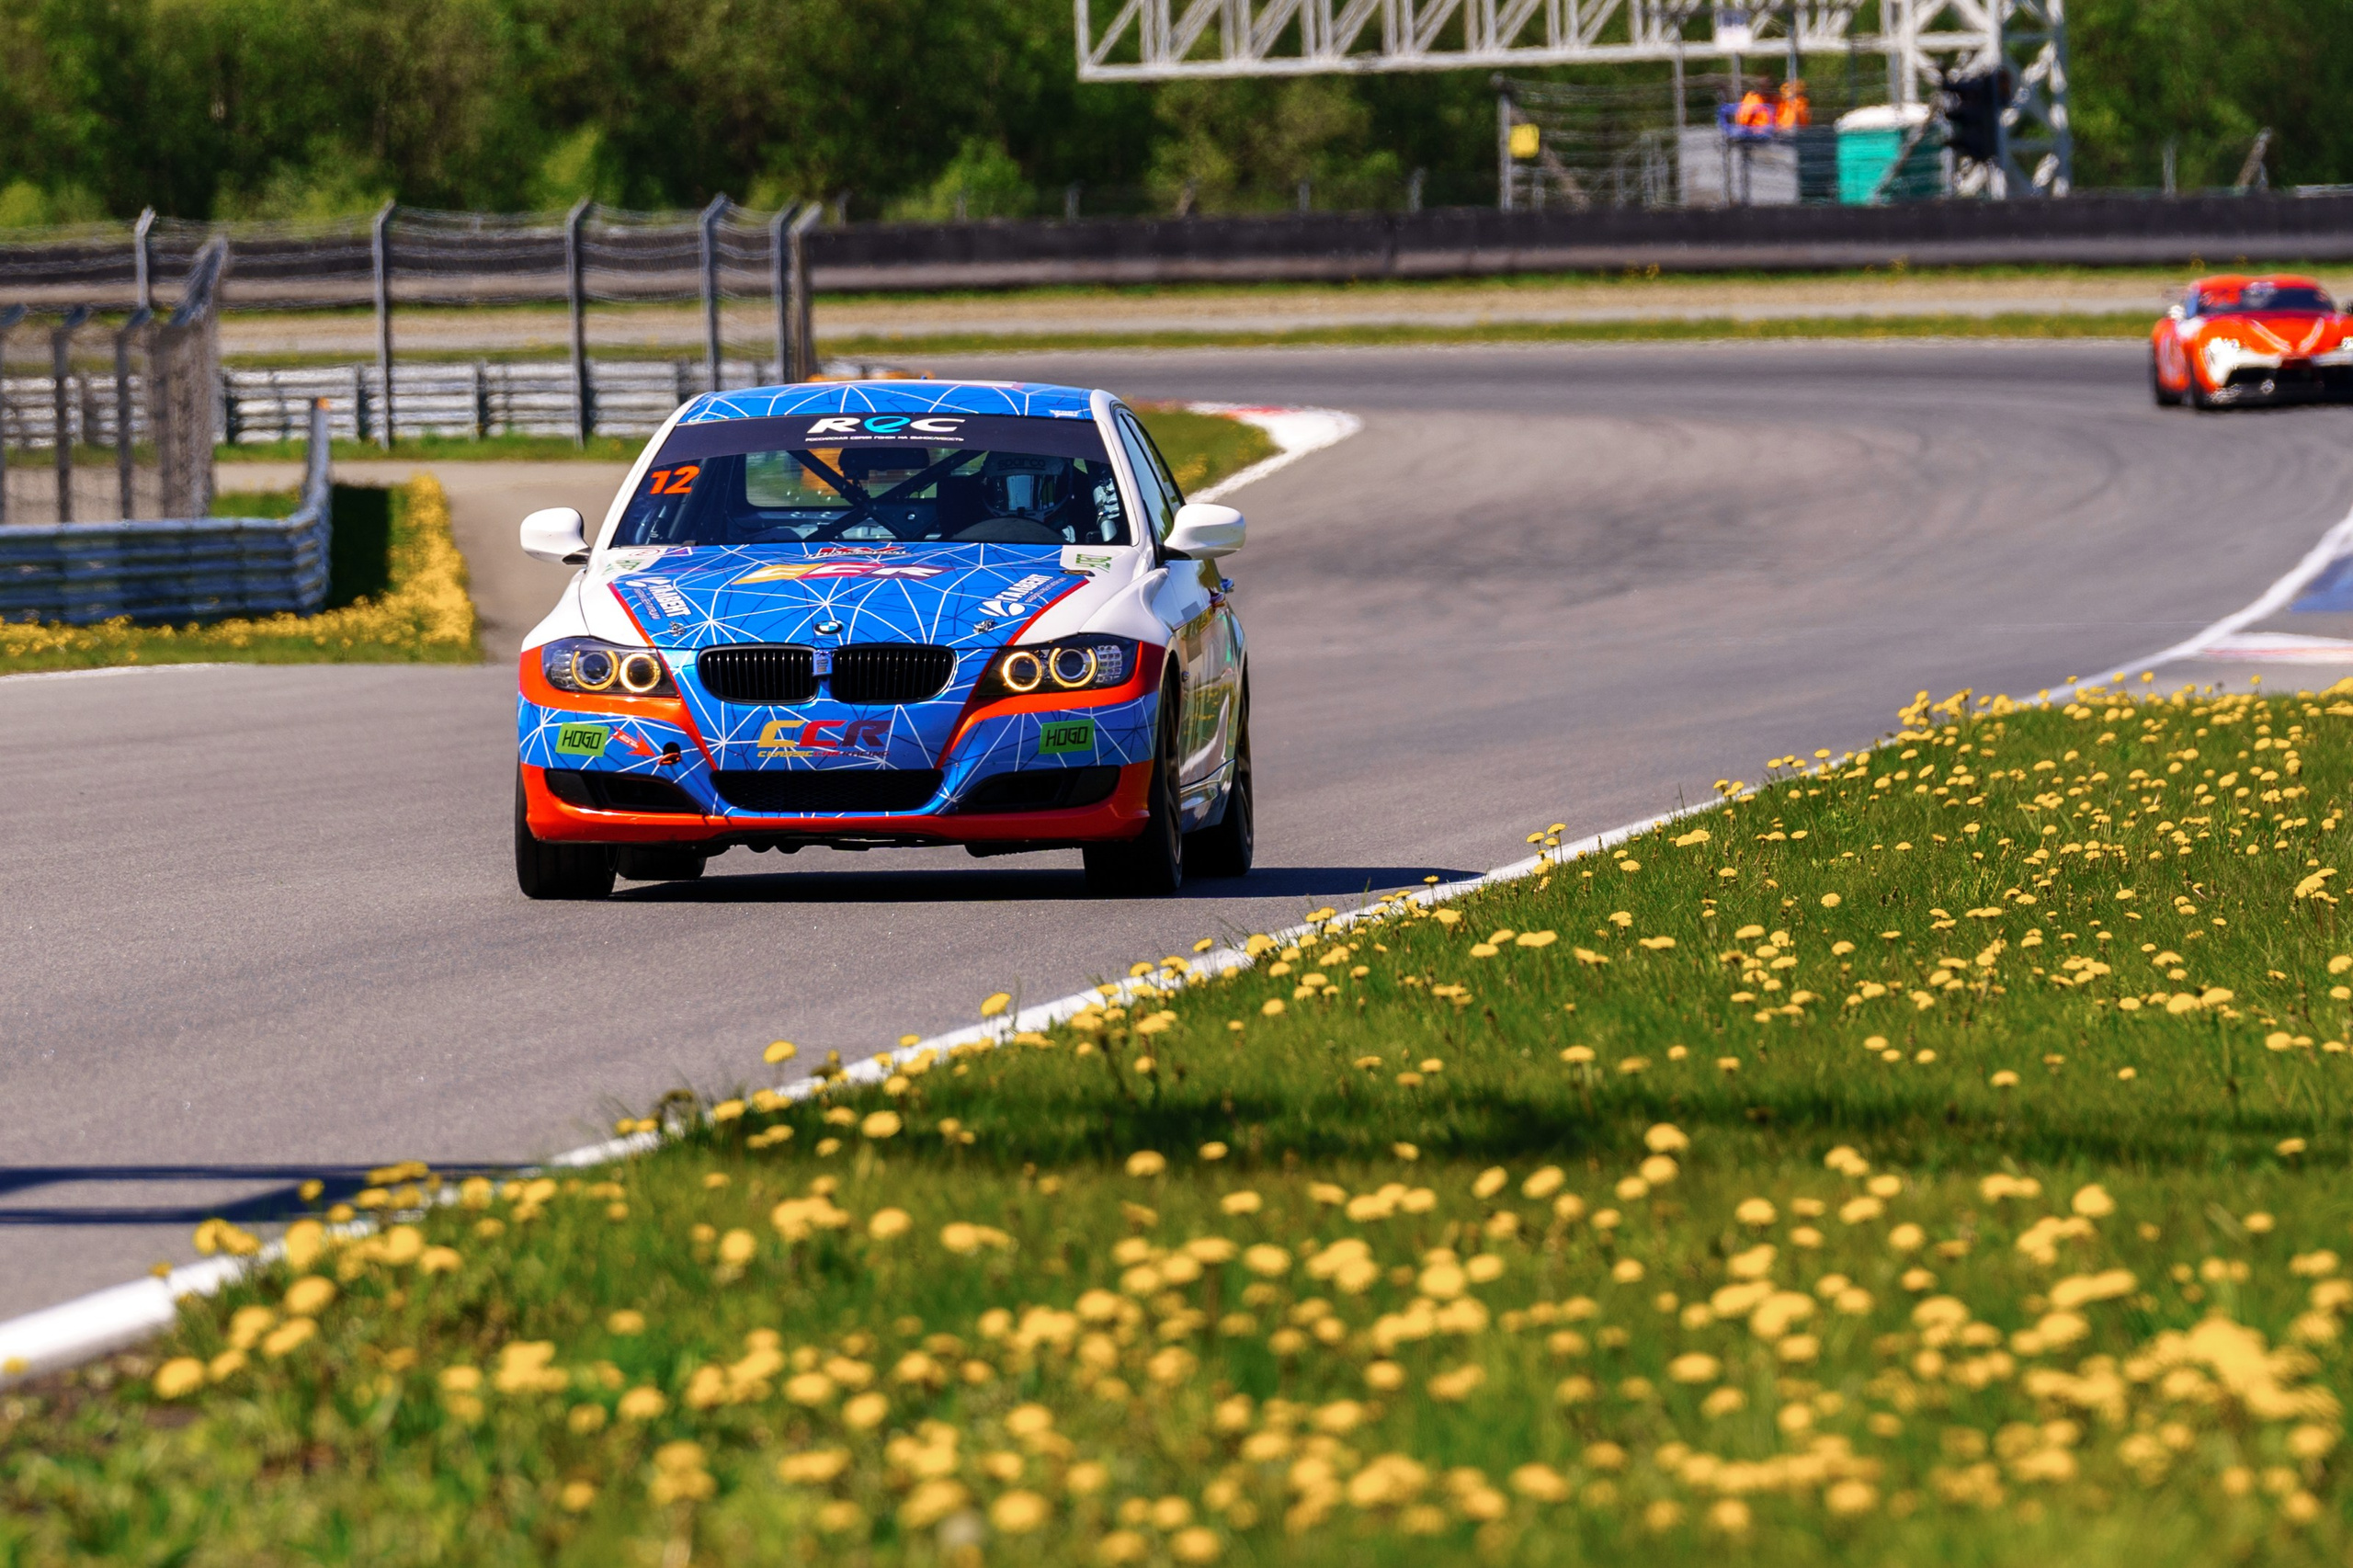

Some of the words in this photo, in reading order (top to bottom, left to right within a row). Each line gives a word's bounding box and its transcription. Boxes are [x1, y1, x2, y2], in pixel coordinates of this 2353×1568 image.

[649, 465, 700, 494] 12
[562, 730, 602, 750] HOGO
[756, 720, 893, 748] CCR
[1045, 726, 1089, 747] HOGO
